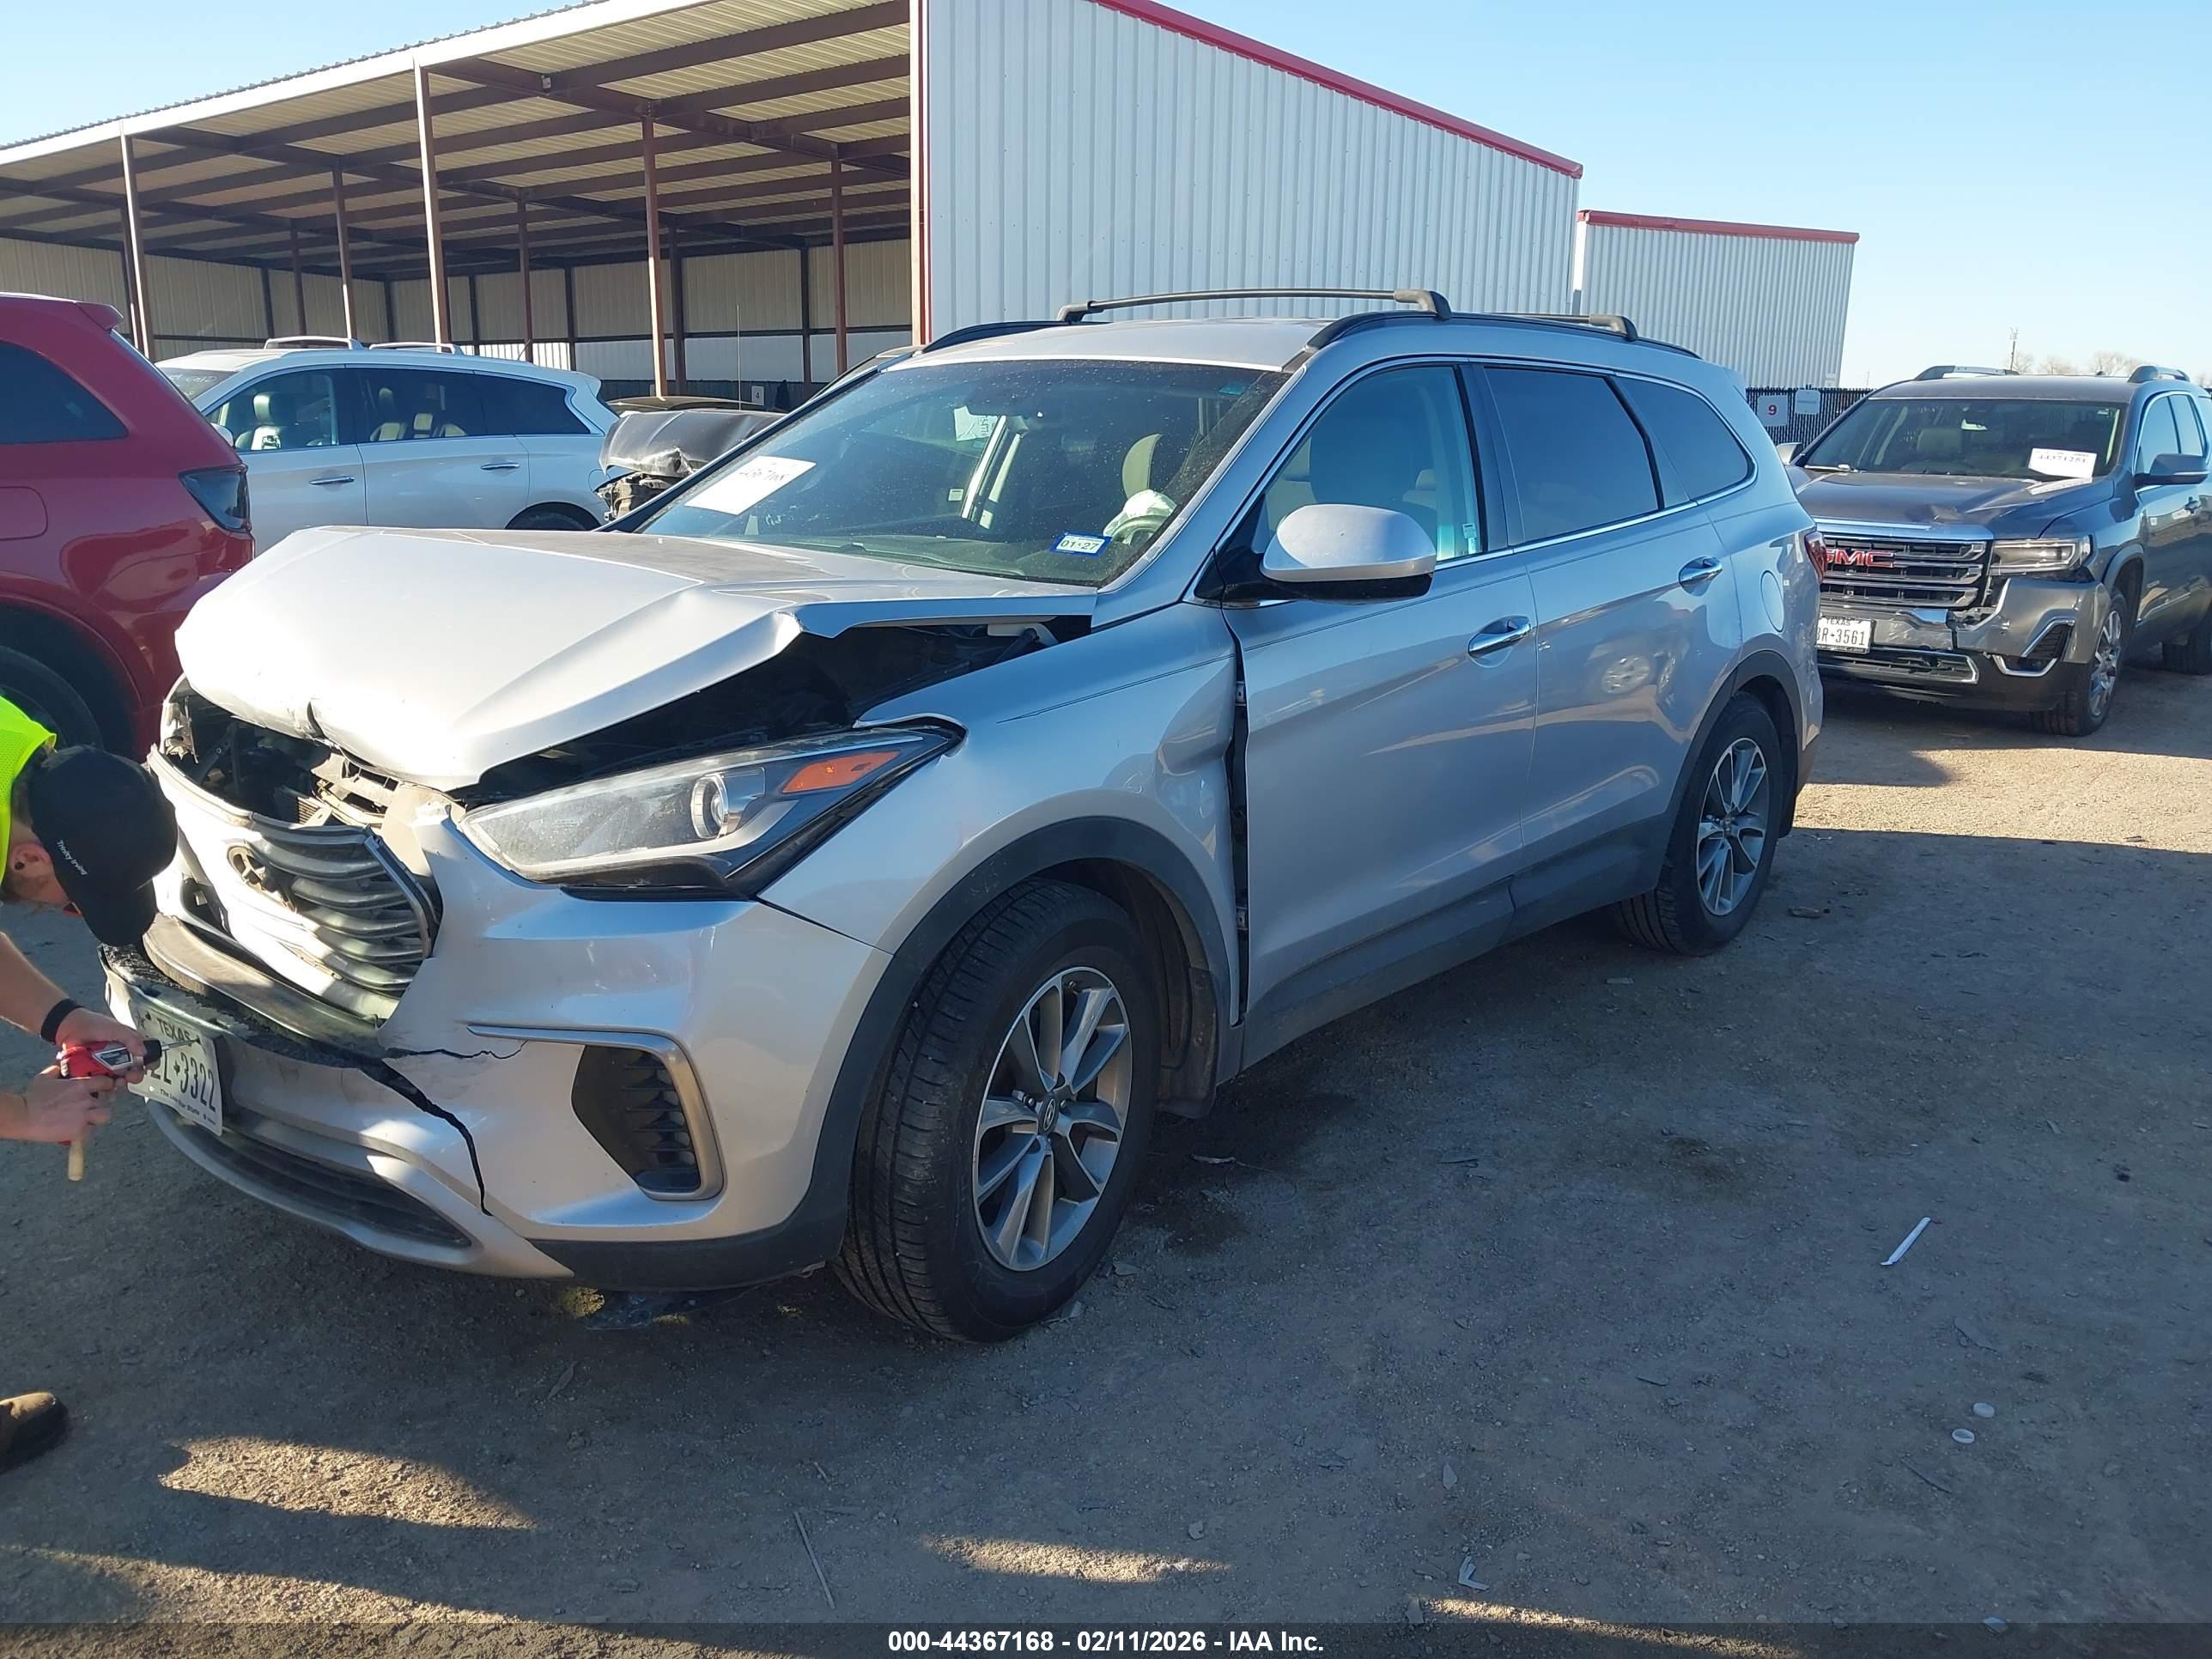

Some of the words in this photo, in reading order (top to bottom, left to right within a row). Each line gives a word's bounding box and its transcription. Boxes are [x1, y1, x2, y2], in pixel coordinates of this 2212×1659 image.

[1768, 404, 1778, 416] 9
[56, 840, 73, 860] Trinity
[70, 859, 88, 875] Irving
[156, 1017, 192, 1042] TEXAS
